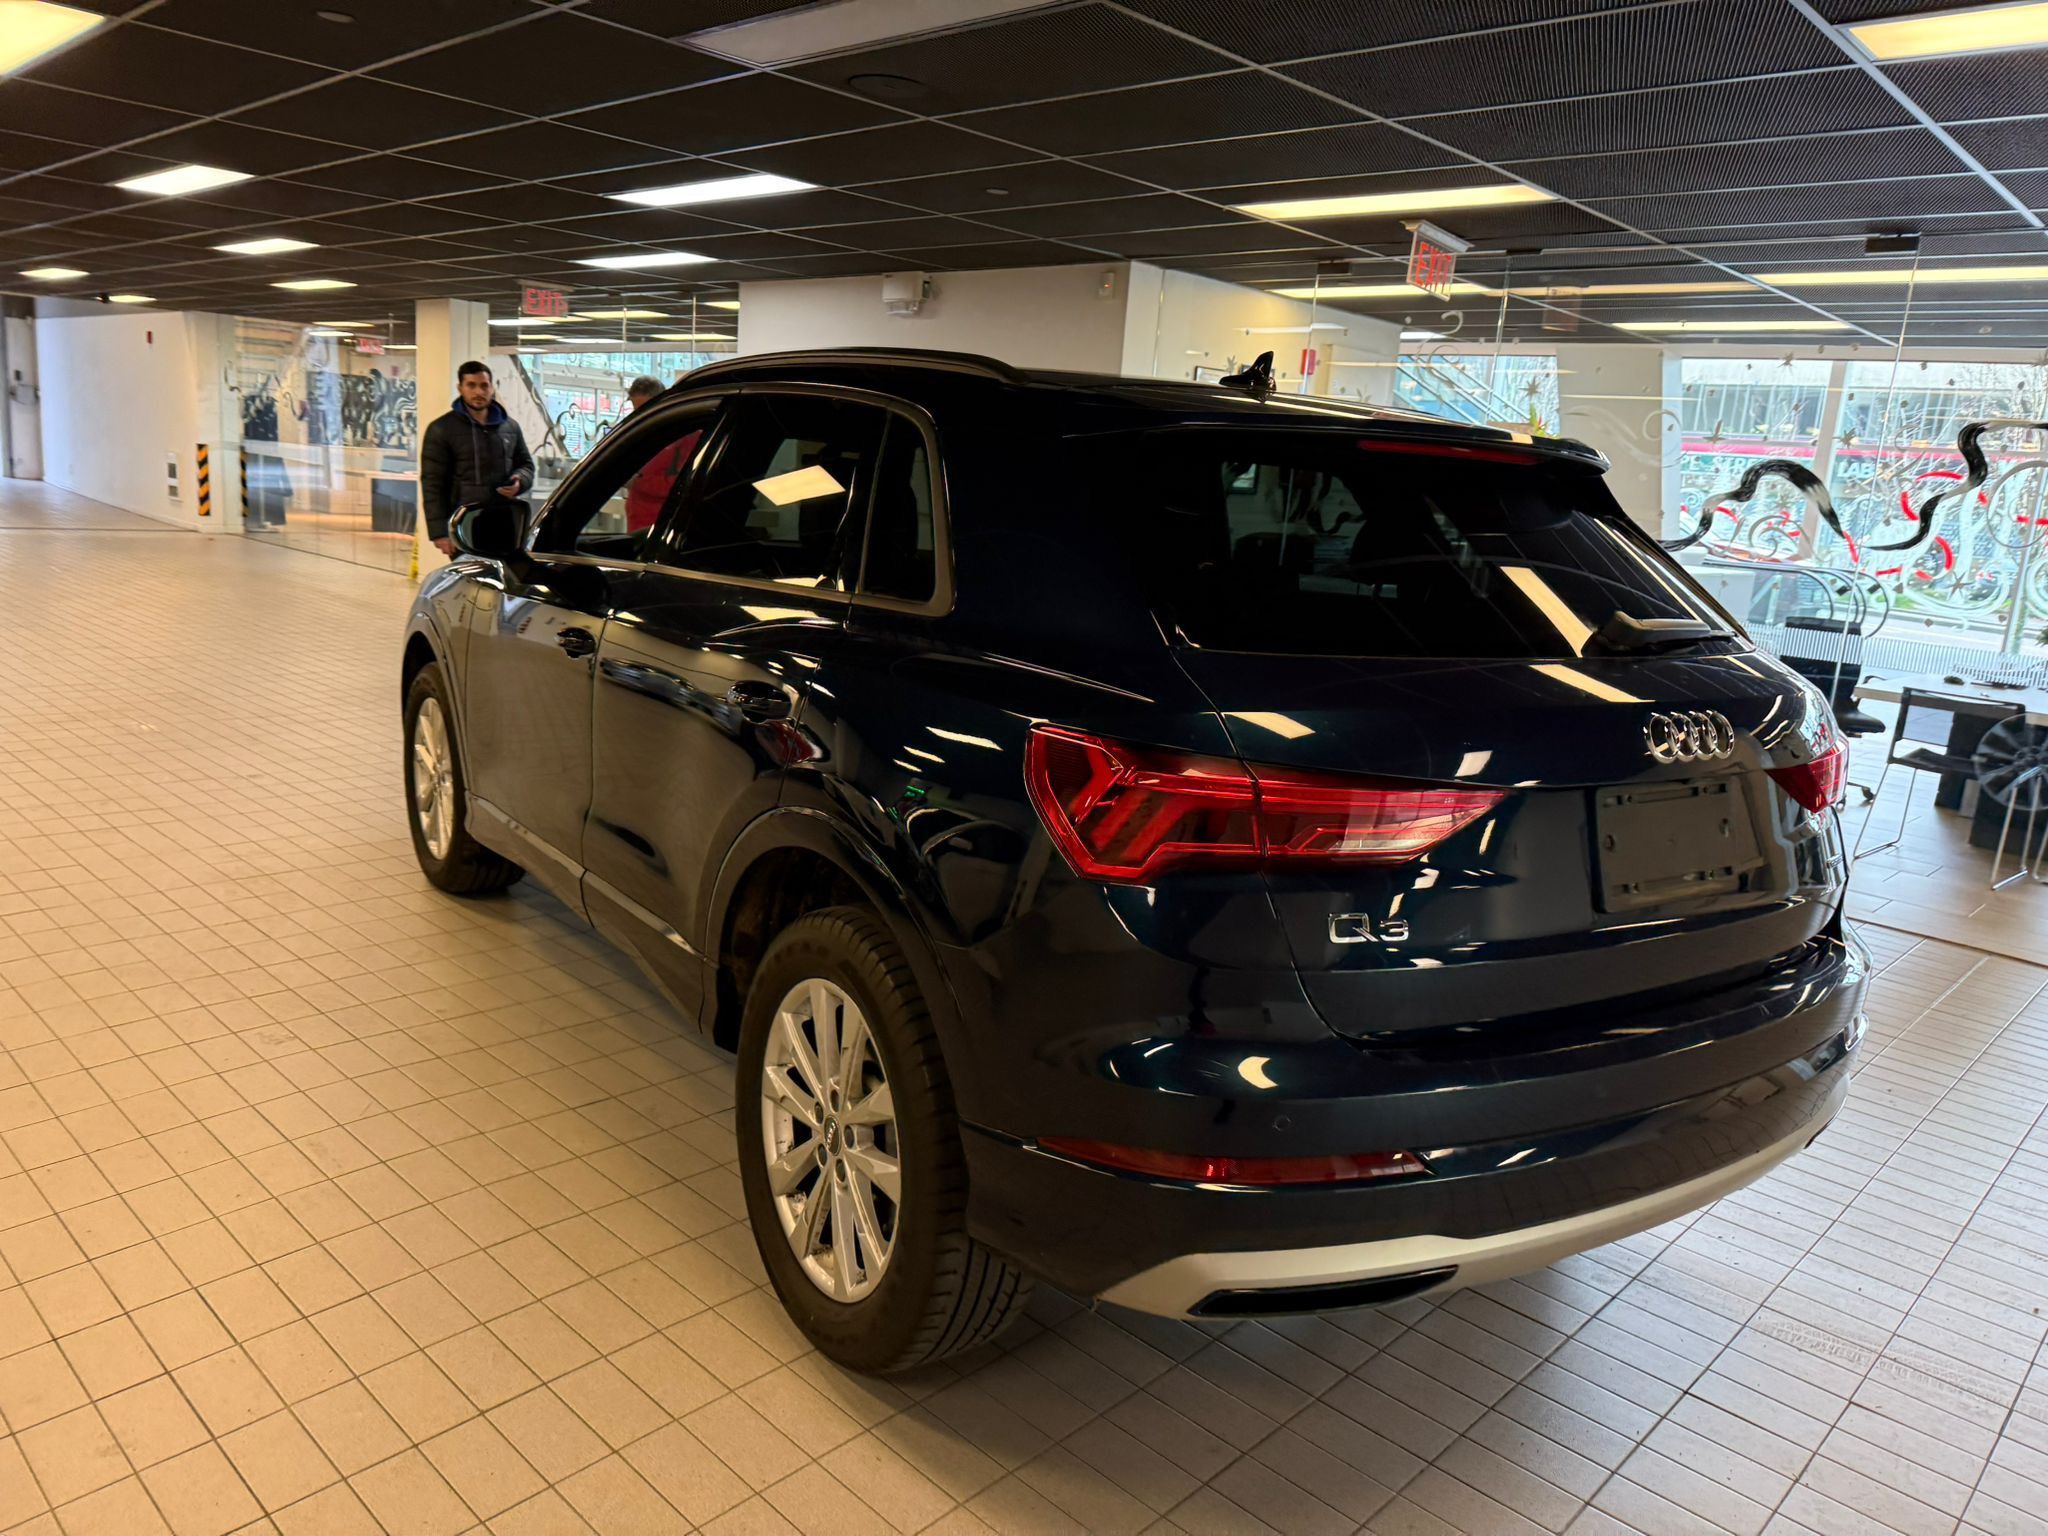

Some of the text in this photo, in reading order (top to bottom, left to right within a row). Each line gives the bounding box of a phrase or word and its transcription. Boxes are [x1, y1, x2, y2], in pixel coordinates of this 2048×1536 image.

[1414, 241, 1453, 294] EXIT
[526, 287, 563, 315] EXIT
[1328, 912, 1409, 943] Q3
